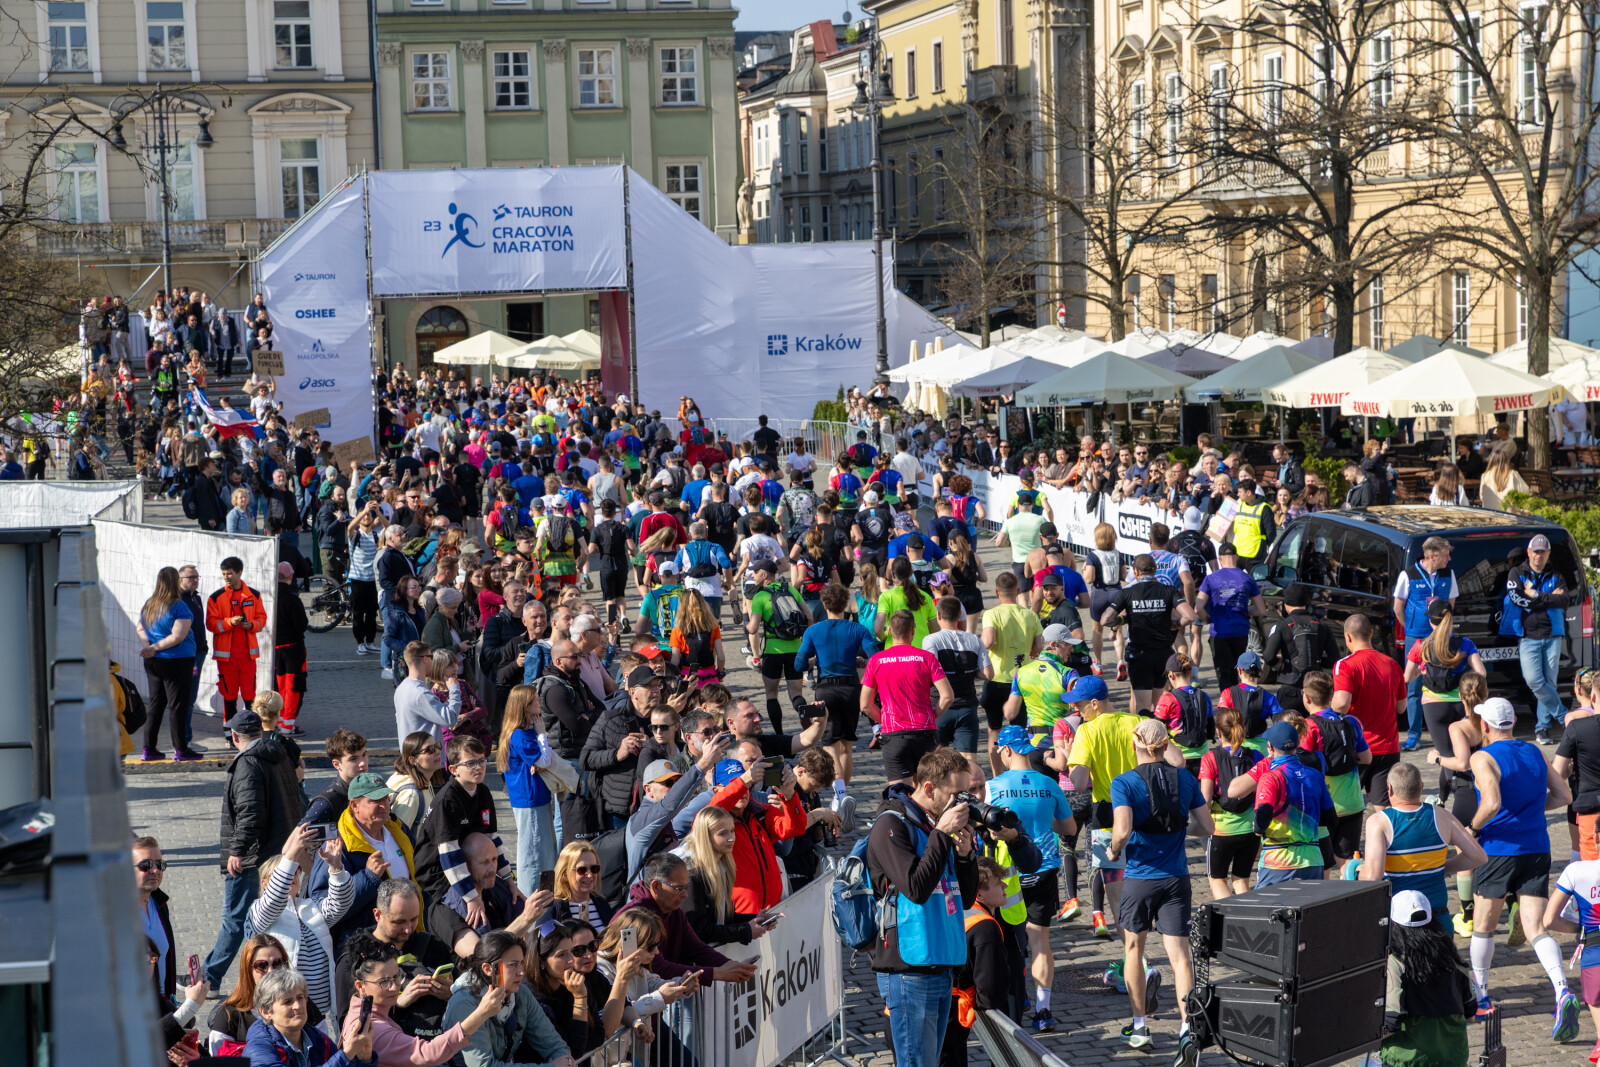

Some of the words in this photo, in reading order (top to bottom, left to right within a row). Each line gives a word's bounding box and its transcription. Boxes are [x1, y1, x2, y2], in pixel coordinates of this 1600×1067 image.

[514, 206, 573, 218] TAURON
[424, 221, 442, 232] 23
[492, 225, 574, 239] CRACOVIA
[493, 240, 574, 254] MARATON
[295, 308, 336, 318] OSHEE
[796, 333, 862, 352] Kraków
[311, 379, 336, 388] asics
[1494, 394, 1534, 411] ŻYWIEC
[1132, 599, 1166, 608] PAWEŁ
[999, 789, 1052, 799] FINISHER
[760, 940, 820, 1021] Kraków
